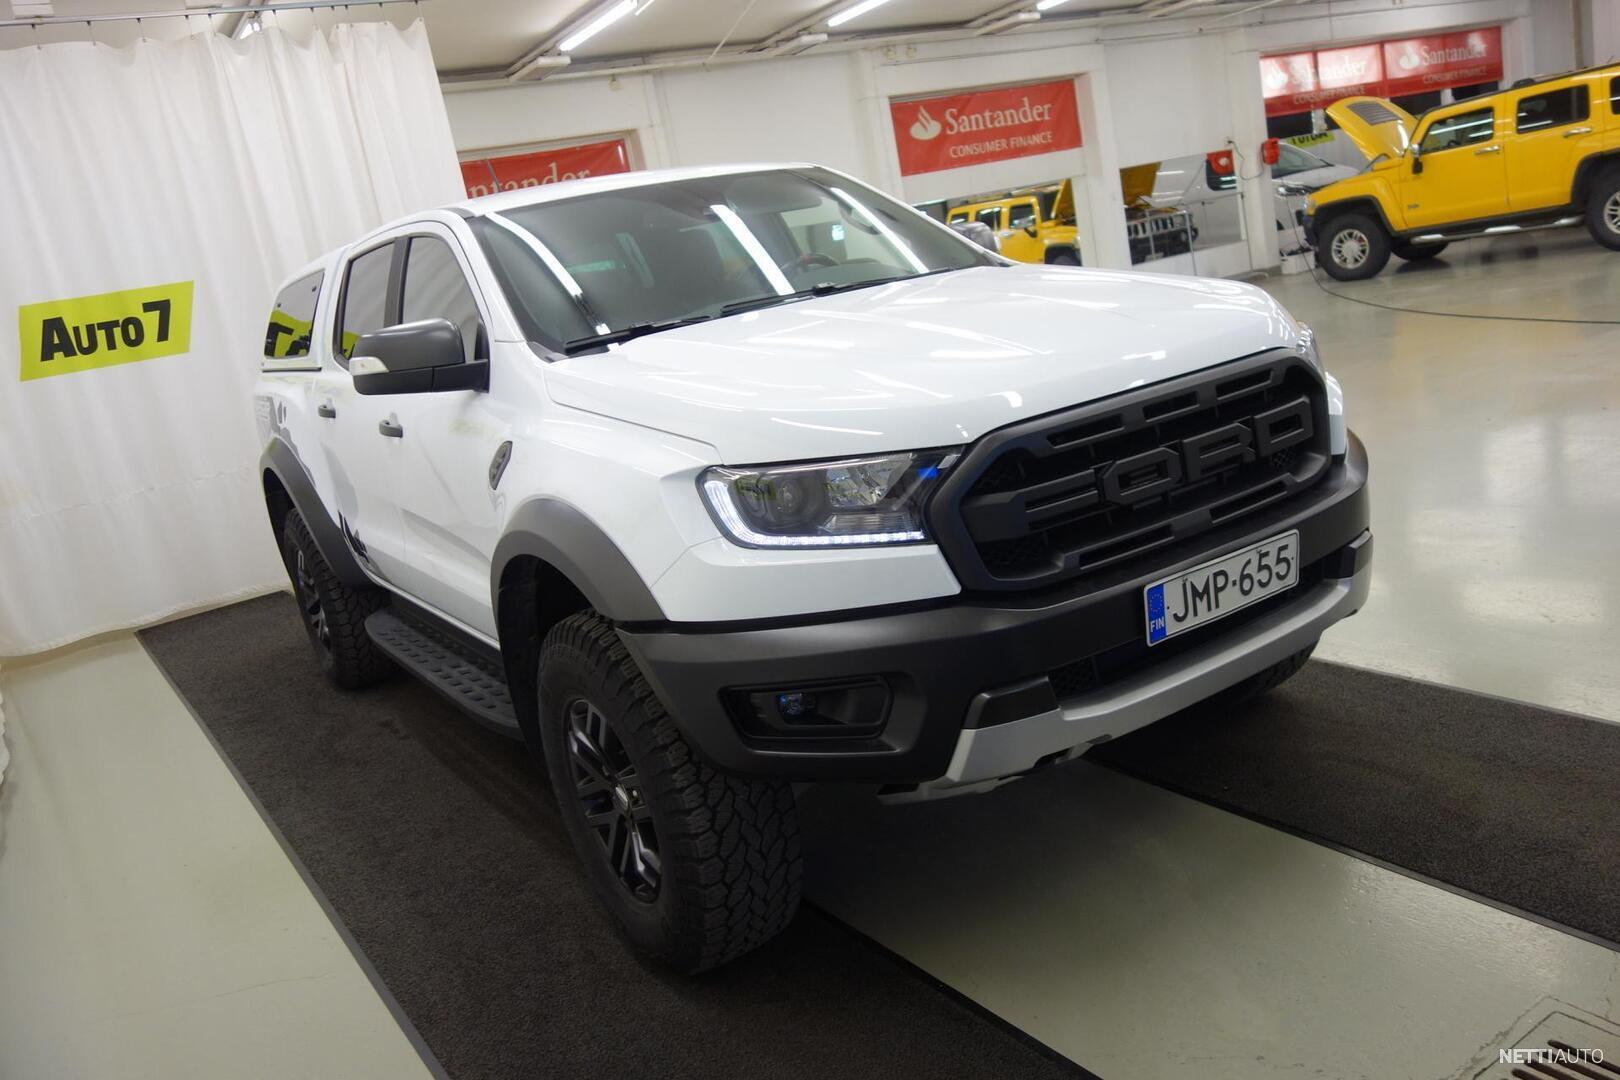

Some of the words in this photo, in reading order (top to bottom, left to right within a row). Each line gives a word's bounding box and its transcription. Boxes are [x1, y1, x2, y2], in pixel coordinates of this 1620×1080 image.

[1421, 36, 1488, 66] Santander
[945, 97, 1052, 135] Santander
[951, 139, 1008, 158] CONSUMER
[1010, 131, 1053, 148] FINANCE
[1010, 395, 1314, 536] FORD
[1173, 544, 1291, 623] JMP-655
[1150, 616, 1165, 633] FIN
